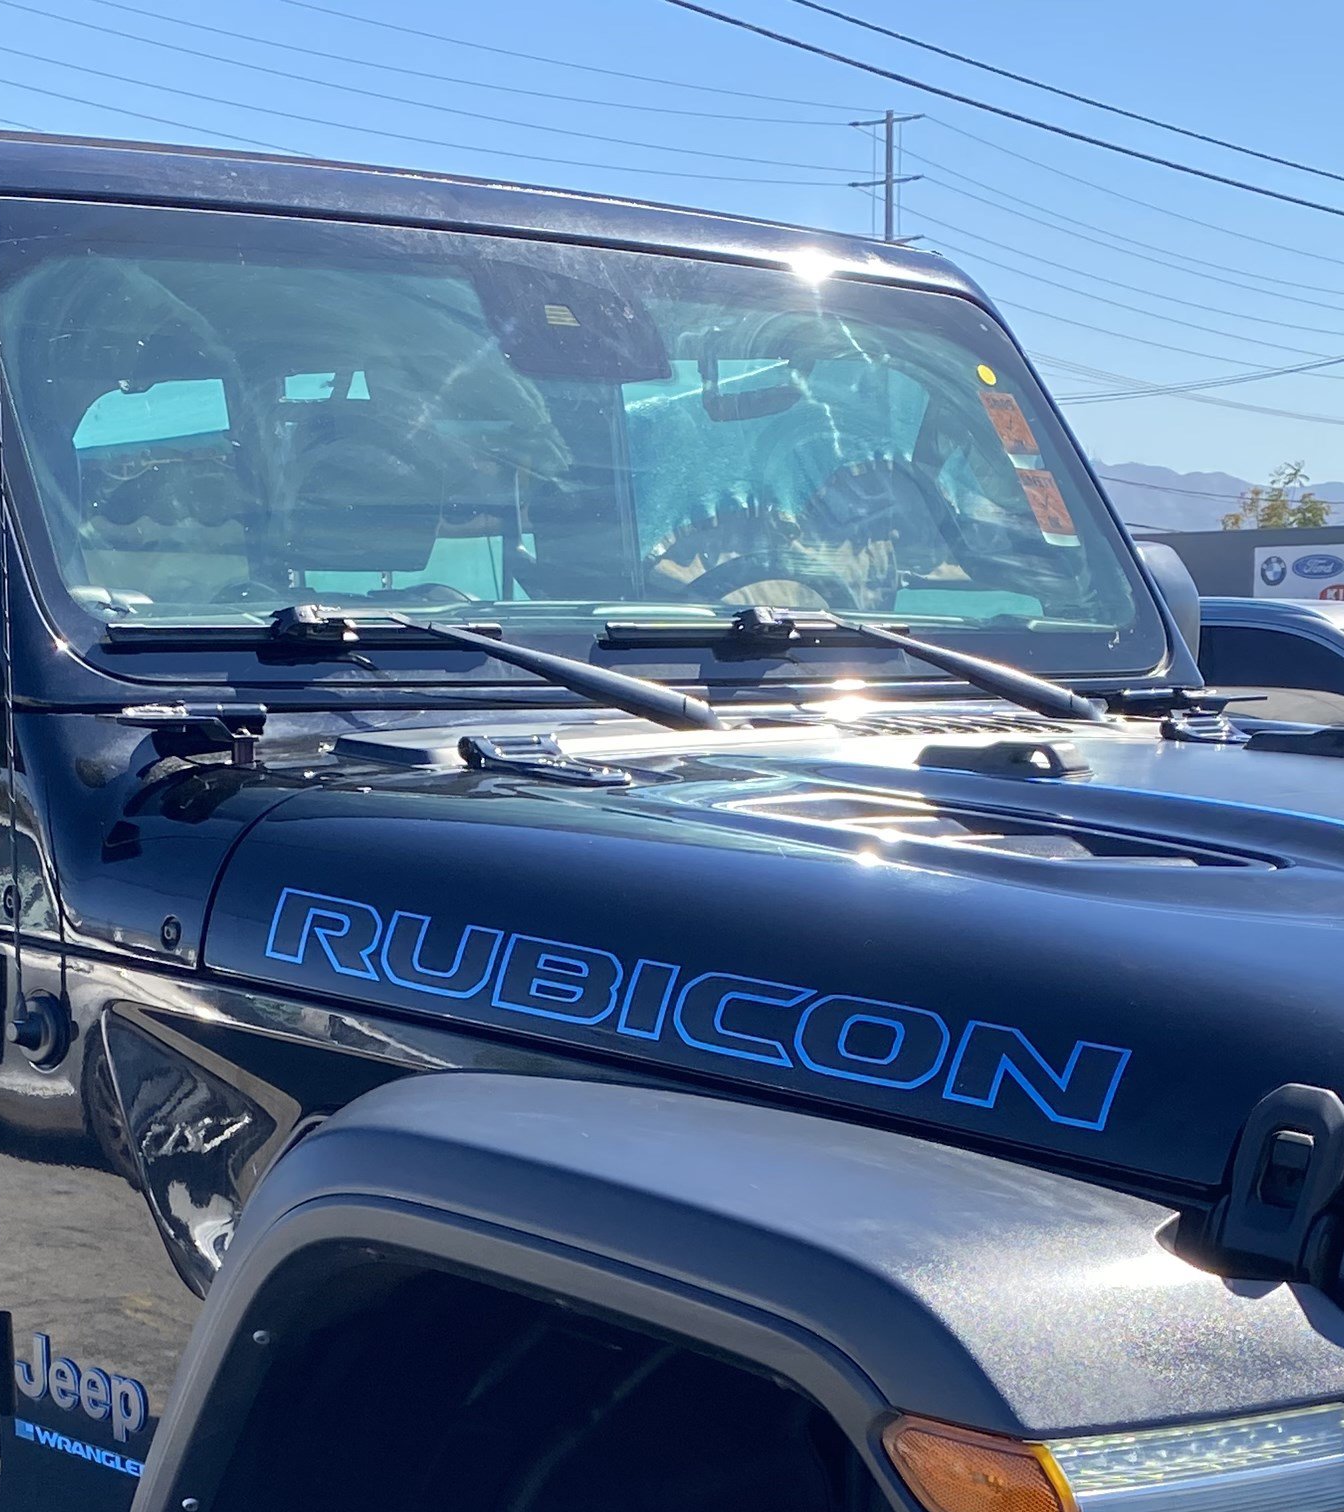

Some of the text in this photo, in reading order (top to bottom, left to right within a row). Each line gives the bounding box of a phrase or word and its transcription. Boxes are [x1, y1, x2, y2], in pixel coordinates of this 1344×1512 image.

[1303, 559, 1336, 574] Ford
[264, 887, 1133, 1131] RUBICON
[14, 1332, 149, 1443] Jeep
